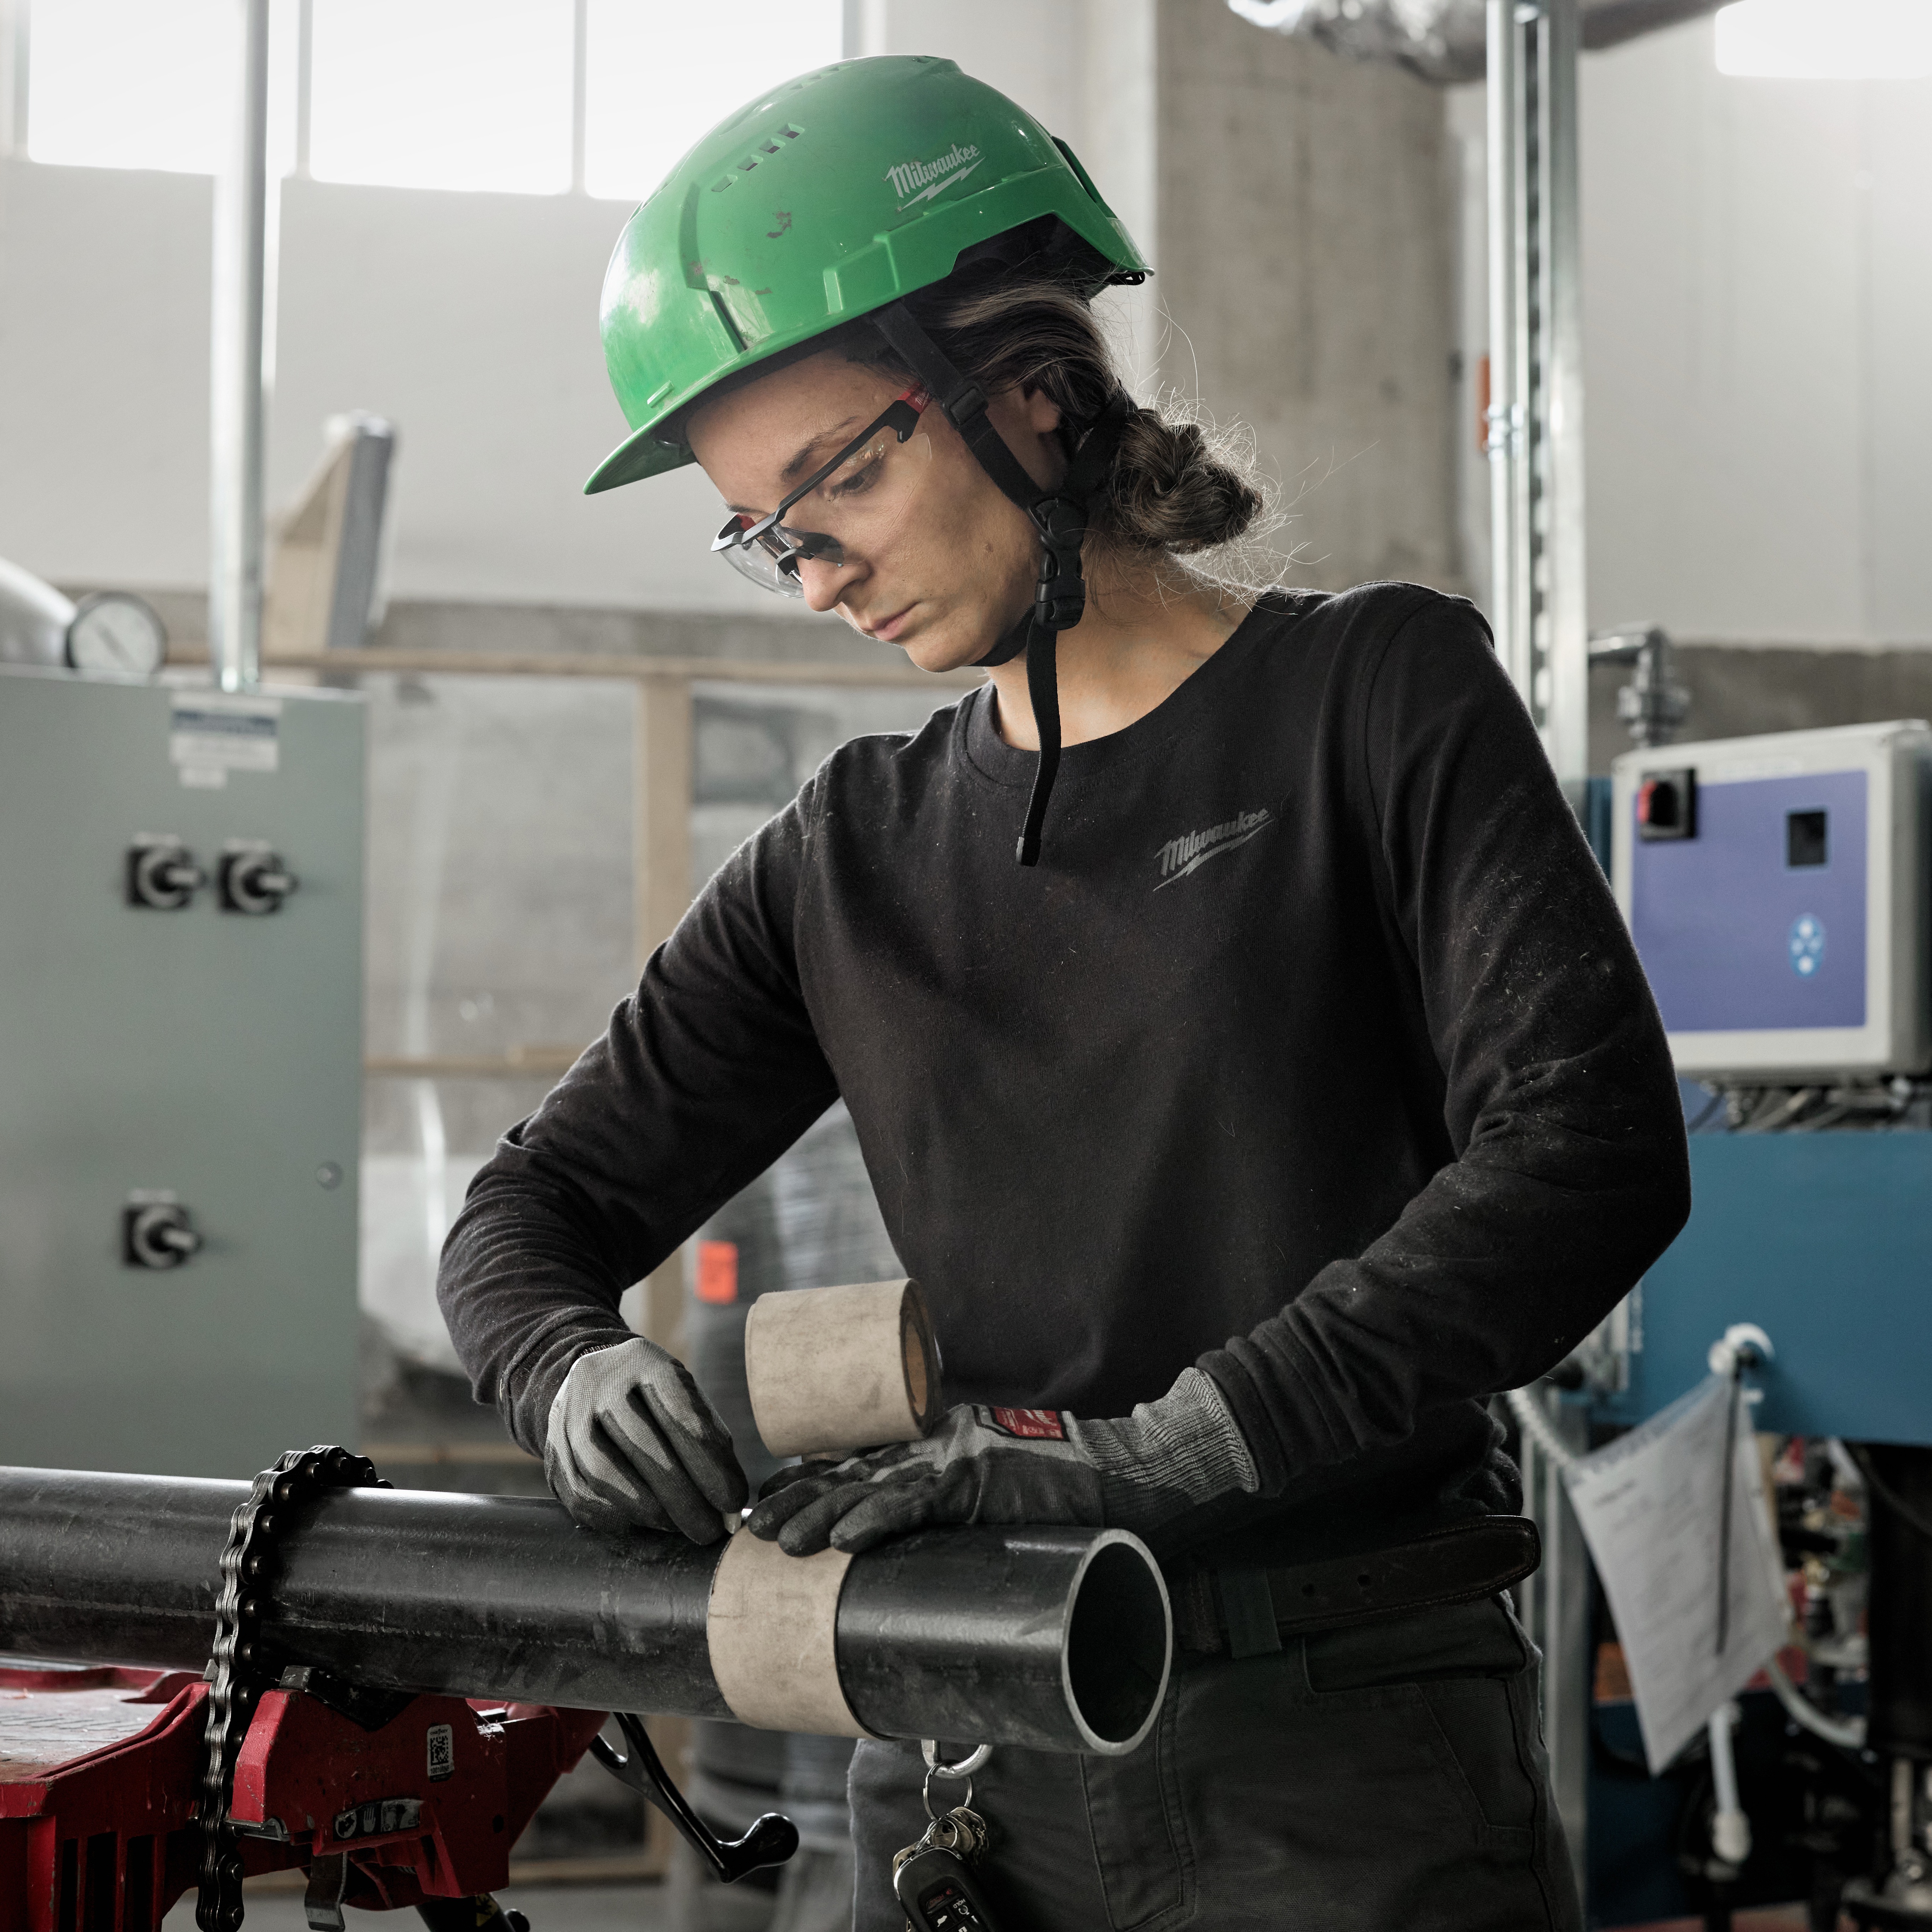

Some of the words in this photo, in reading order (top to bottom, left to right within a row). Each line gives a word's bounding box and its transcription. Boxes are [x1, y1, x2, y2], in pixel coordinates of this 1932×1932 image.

[885, 143, 980, 198] Milwaukee
[1153, 808, 1271, 876] Milwaukee
[953, 1898, 965, 1909] HOLD
